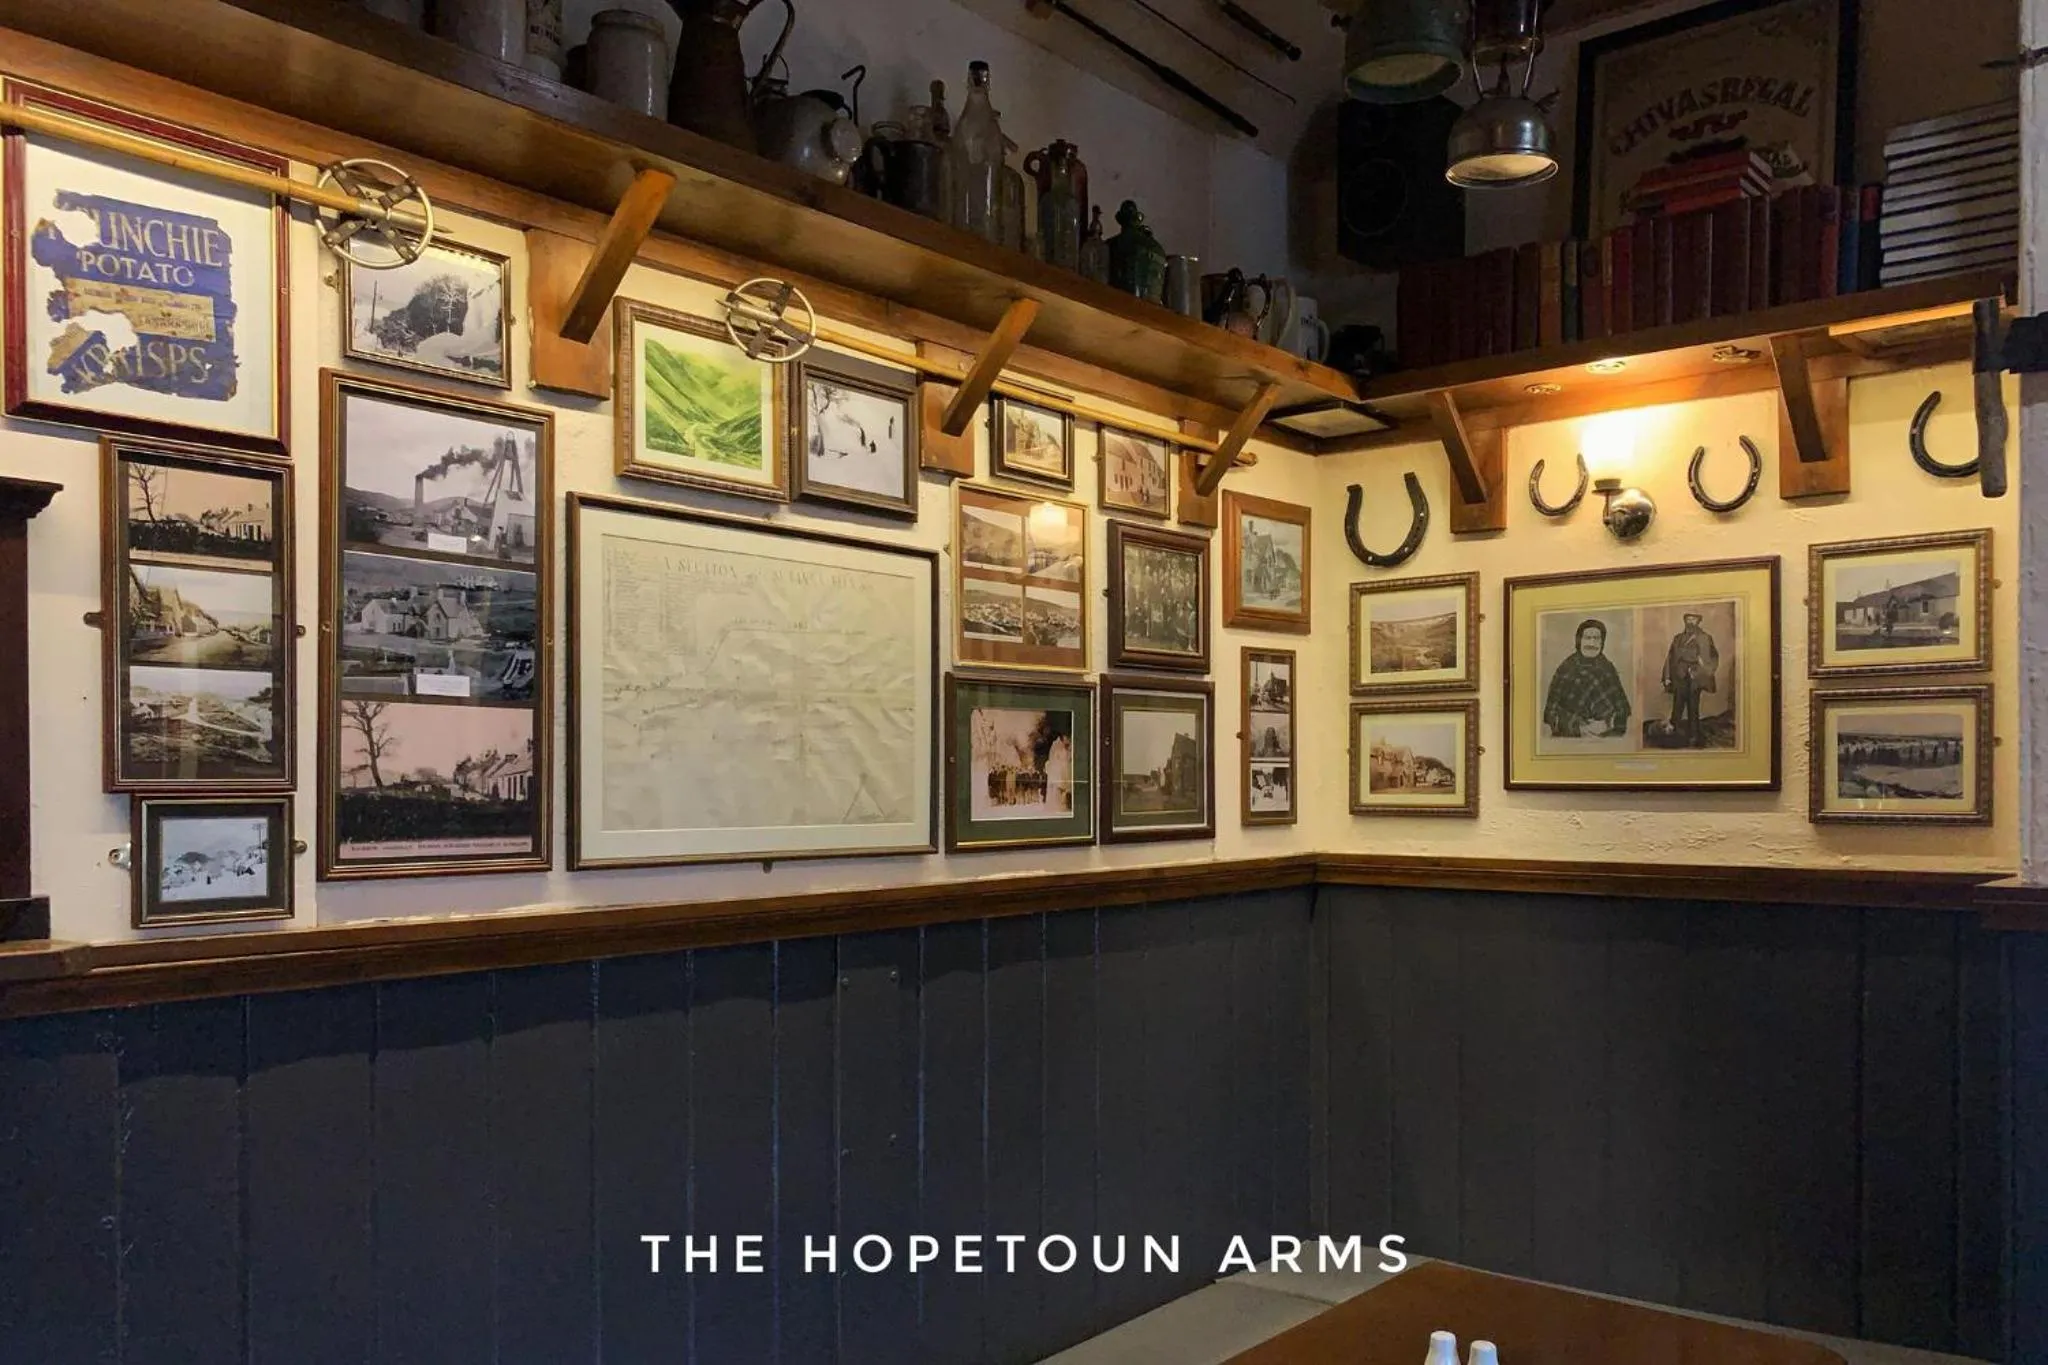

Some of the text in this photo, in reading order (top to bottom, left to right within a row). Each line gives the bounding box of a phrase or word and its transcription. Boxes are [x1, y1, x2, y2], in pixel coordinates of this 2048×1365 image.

[1608, 75, 1816, 155] CHIVAS REGAL
[49, 206, 222, 268] UNCHIE
[79, 251, 196, 287] POTATO
